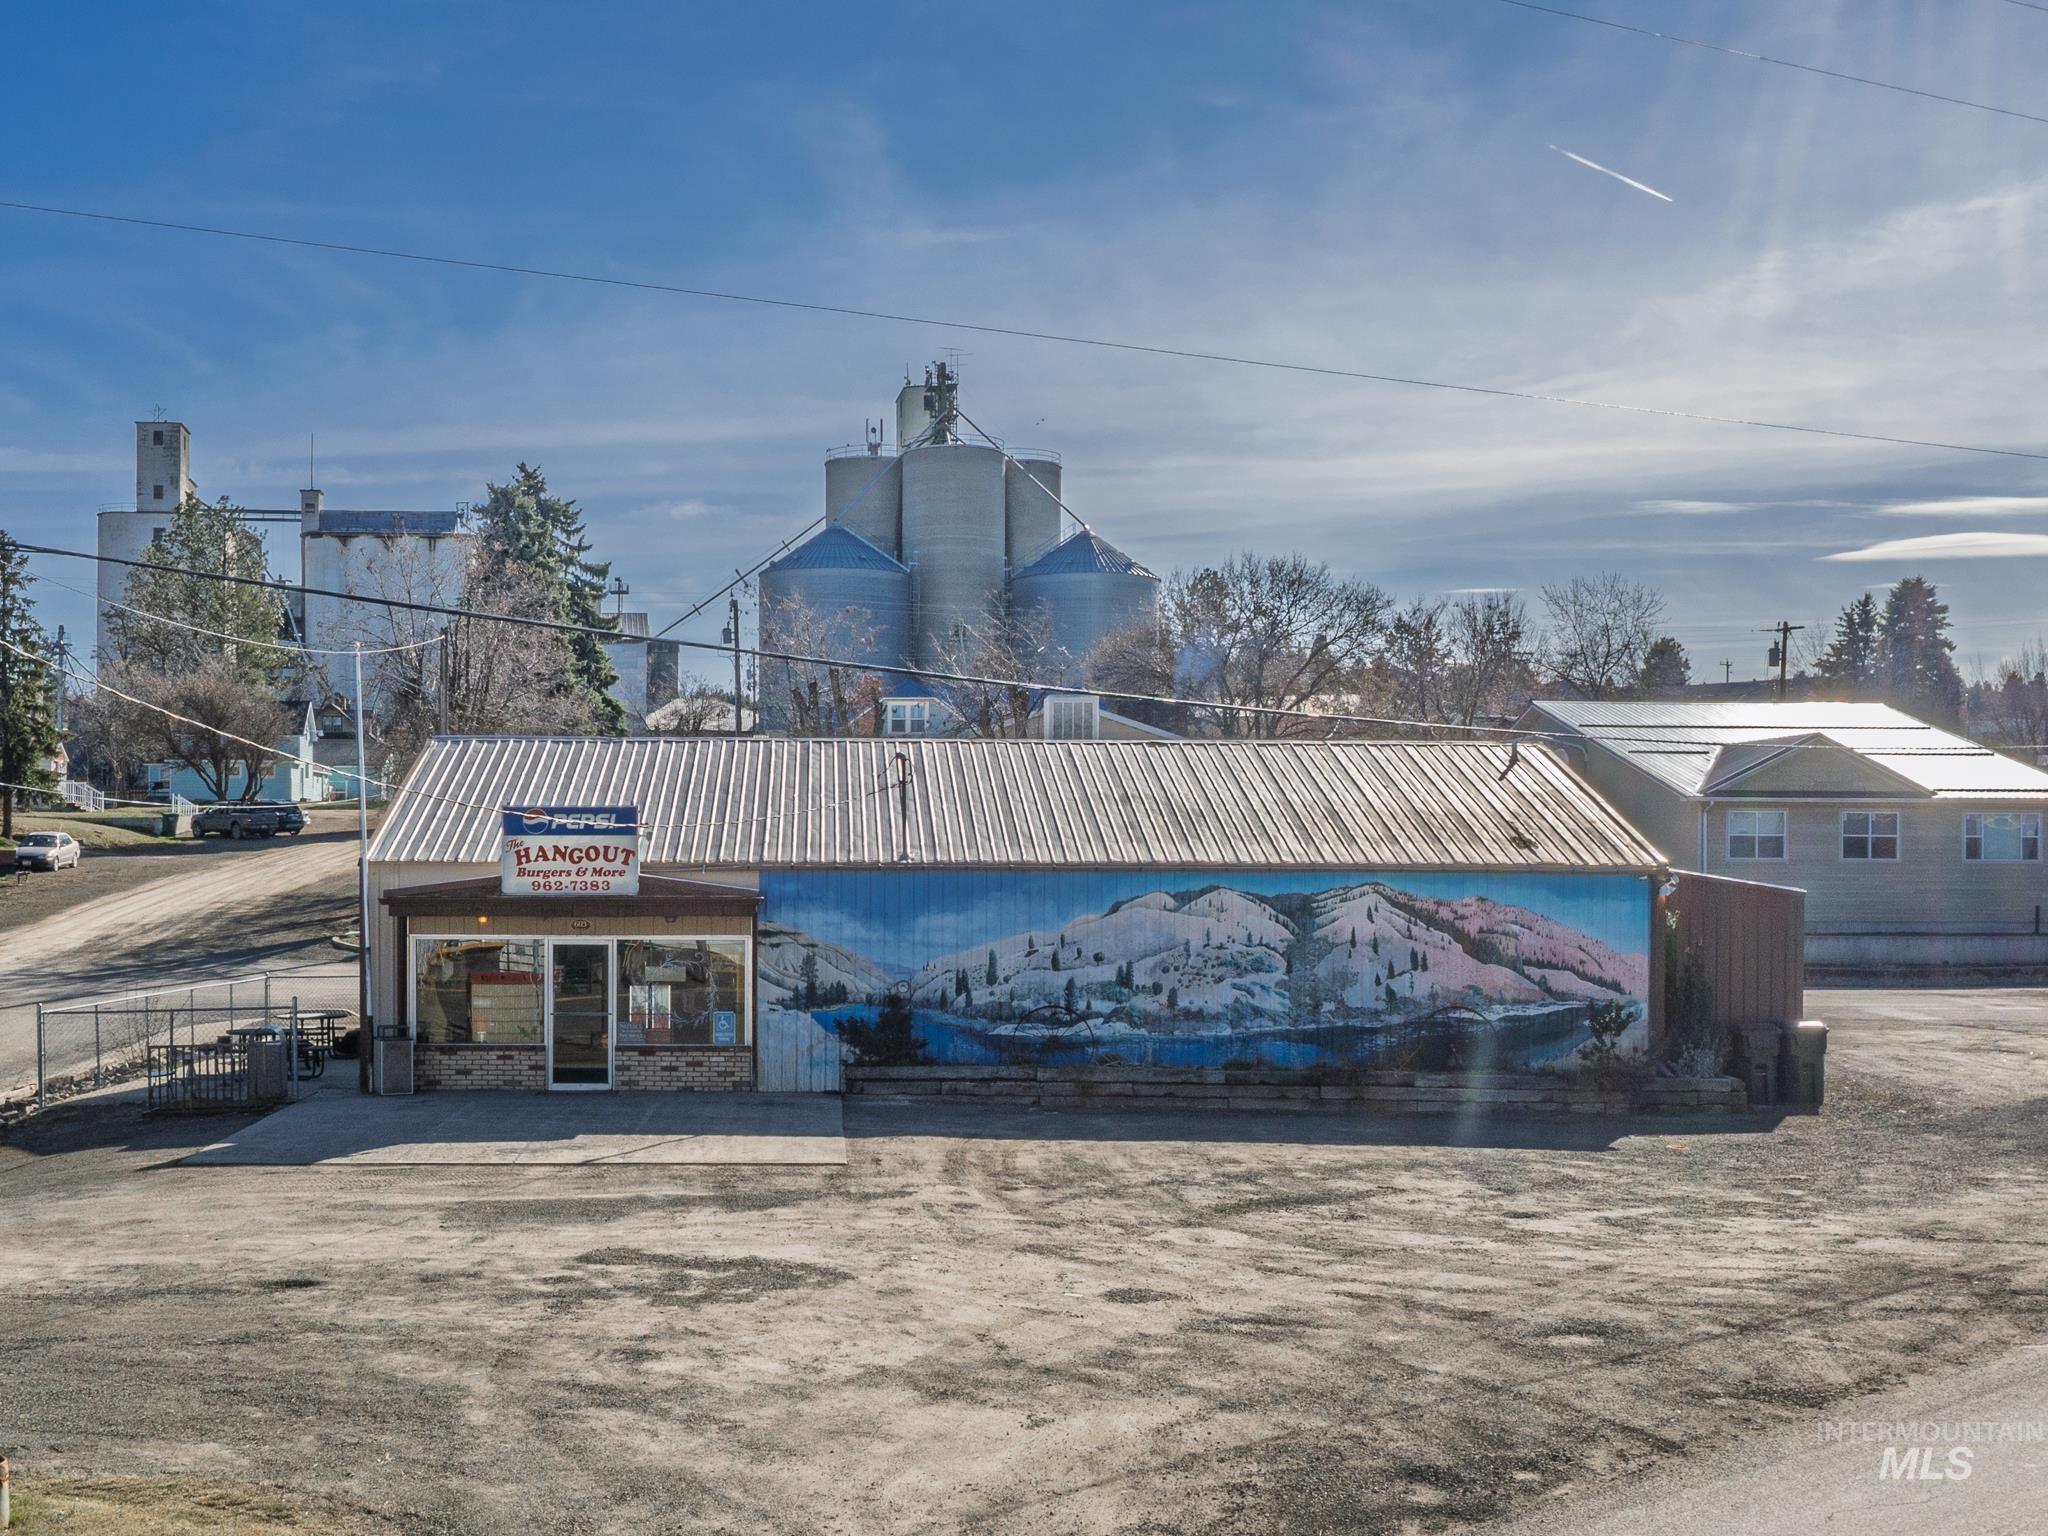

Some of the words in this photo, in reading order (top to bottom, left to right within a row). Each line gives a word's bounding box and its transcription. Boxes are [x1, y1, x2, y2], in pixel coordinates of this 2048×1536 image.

[551, 813, 616, 829] PEPSI
[506, 839, 524, 853] The
[515, 845, 636, 867] HANGOUT
[516, 867, 572, 879] Burgers
[575, 867, 588, 877] &
[590, 867, 626, 877] More
[531, 881, 611, 892] 962-7383
